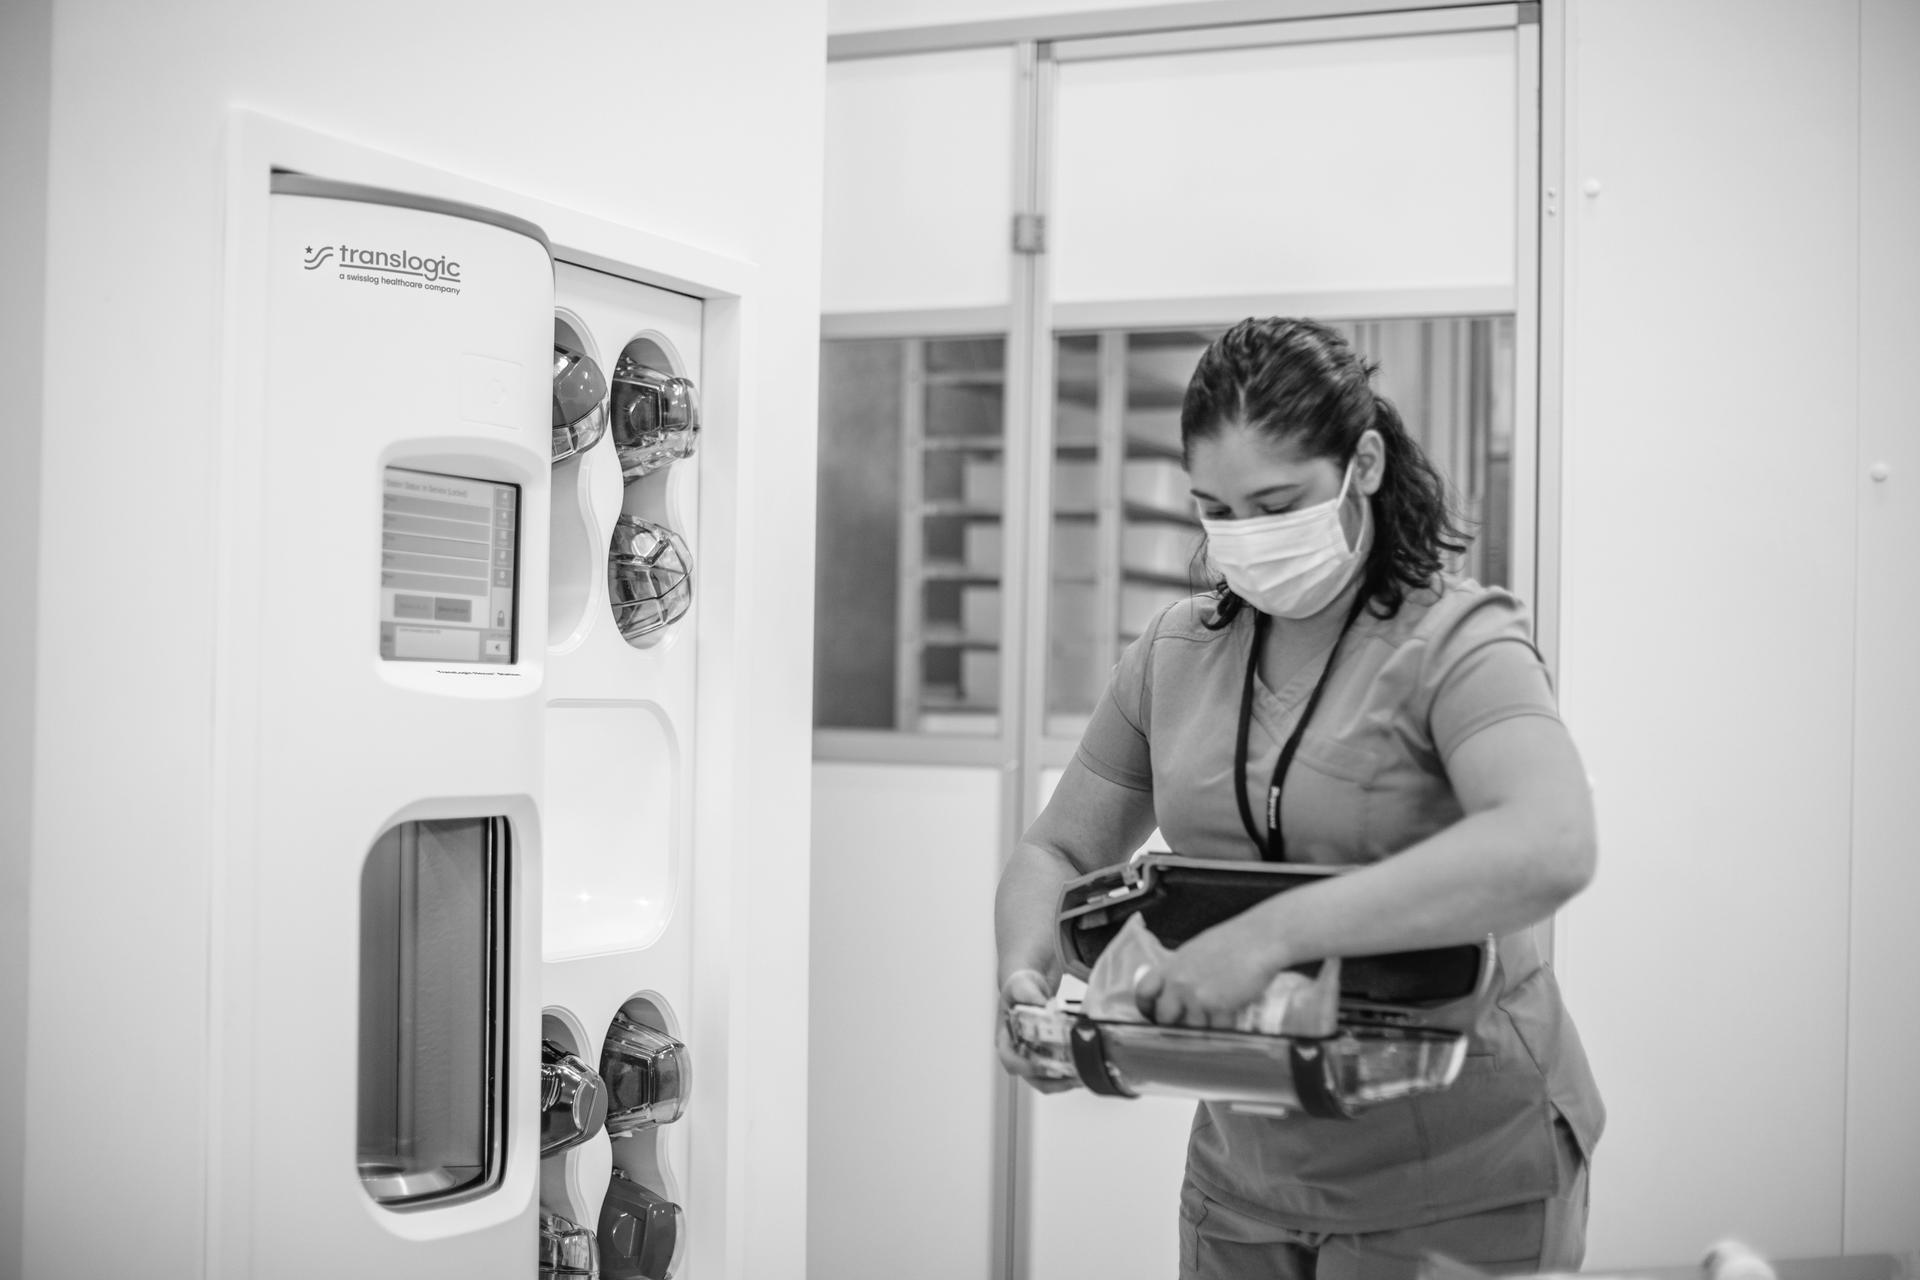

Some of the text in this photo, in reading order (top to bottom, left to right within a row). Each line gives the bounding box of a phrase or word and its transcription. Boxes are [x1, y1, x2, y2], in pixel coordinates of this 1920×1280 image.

[339, 244, 460, 281] translogic
[346, 273, 379, 285] swisslog
[381, 276, 423, 289] healthcare
[424, 283, 461, 296] company
